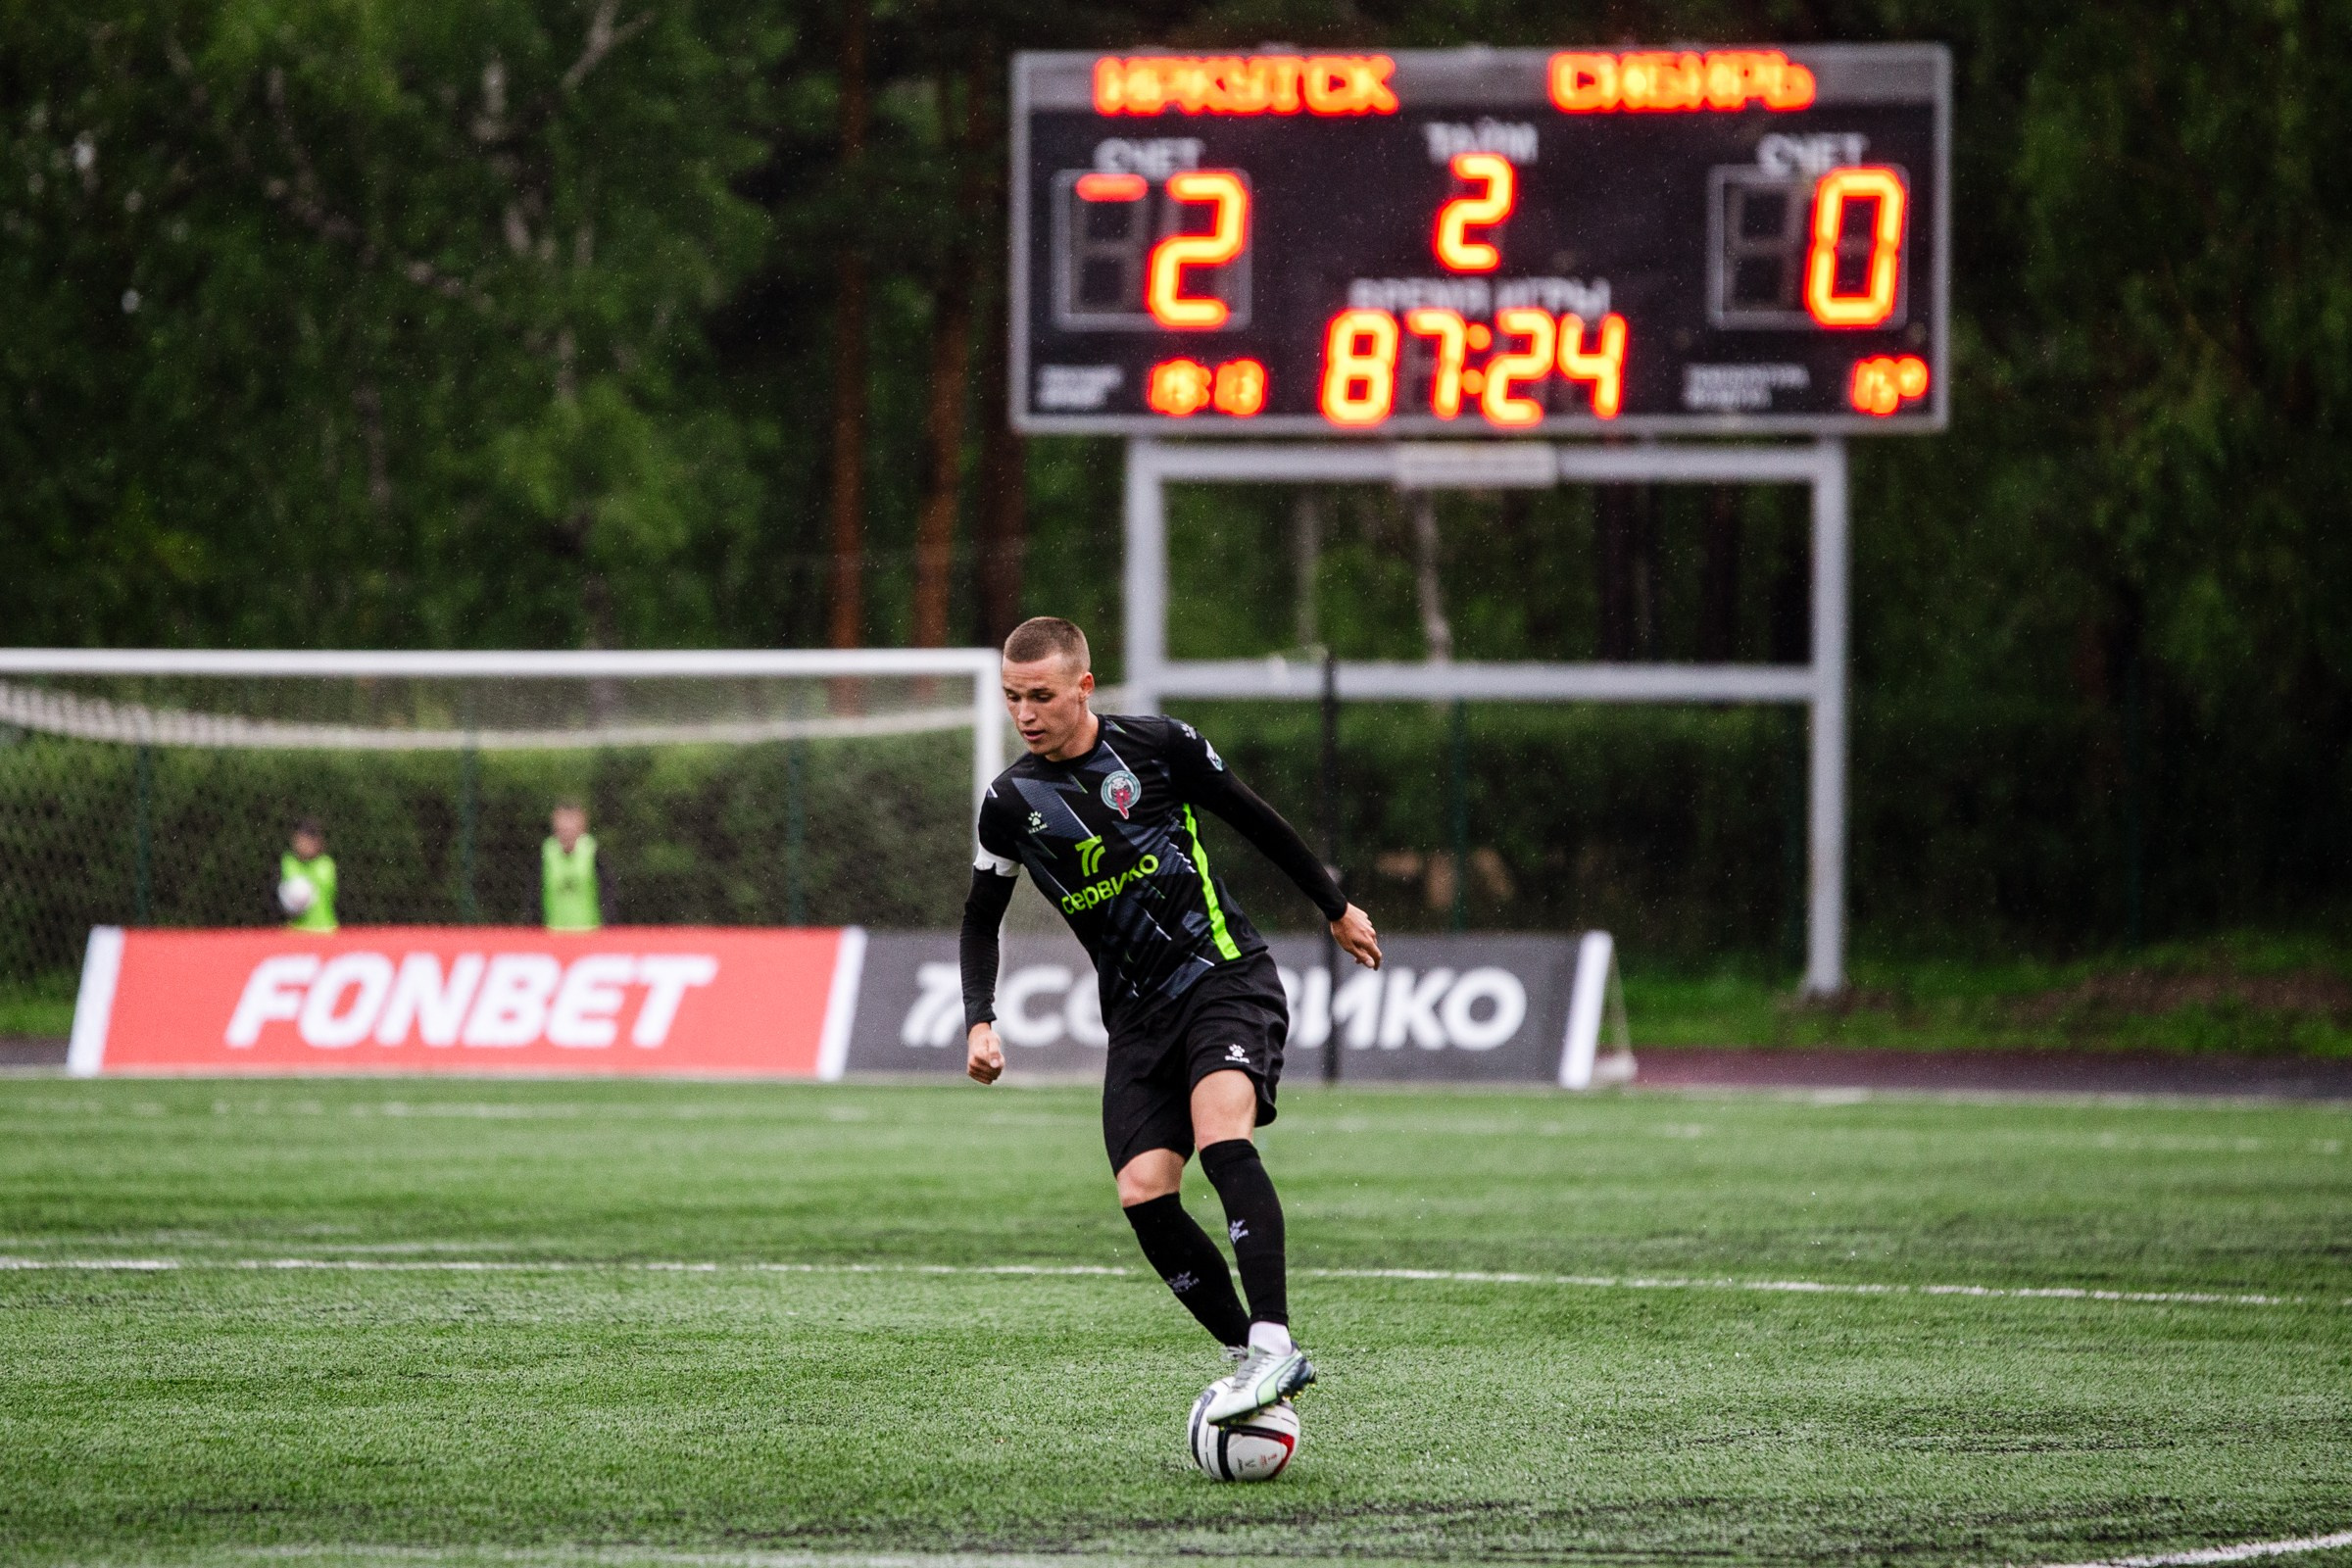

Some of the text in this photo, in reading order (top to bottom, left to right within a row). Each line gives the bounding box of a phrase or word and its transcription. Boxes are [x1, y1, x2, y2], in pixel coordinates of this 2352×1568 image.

[1432, 152, 1516, 273] 2
[1803, 166, 1907, 329] 0
[1317, 306, 1628, 429] 87:24
[224, 952, 718, 1049] FONBET
